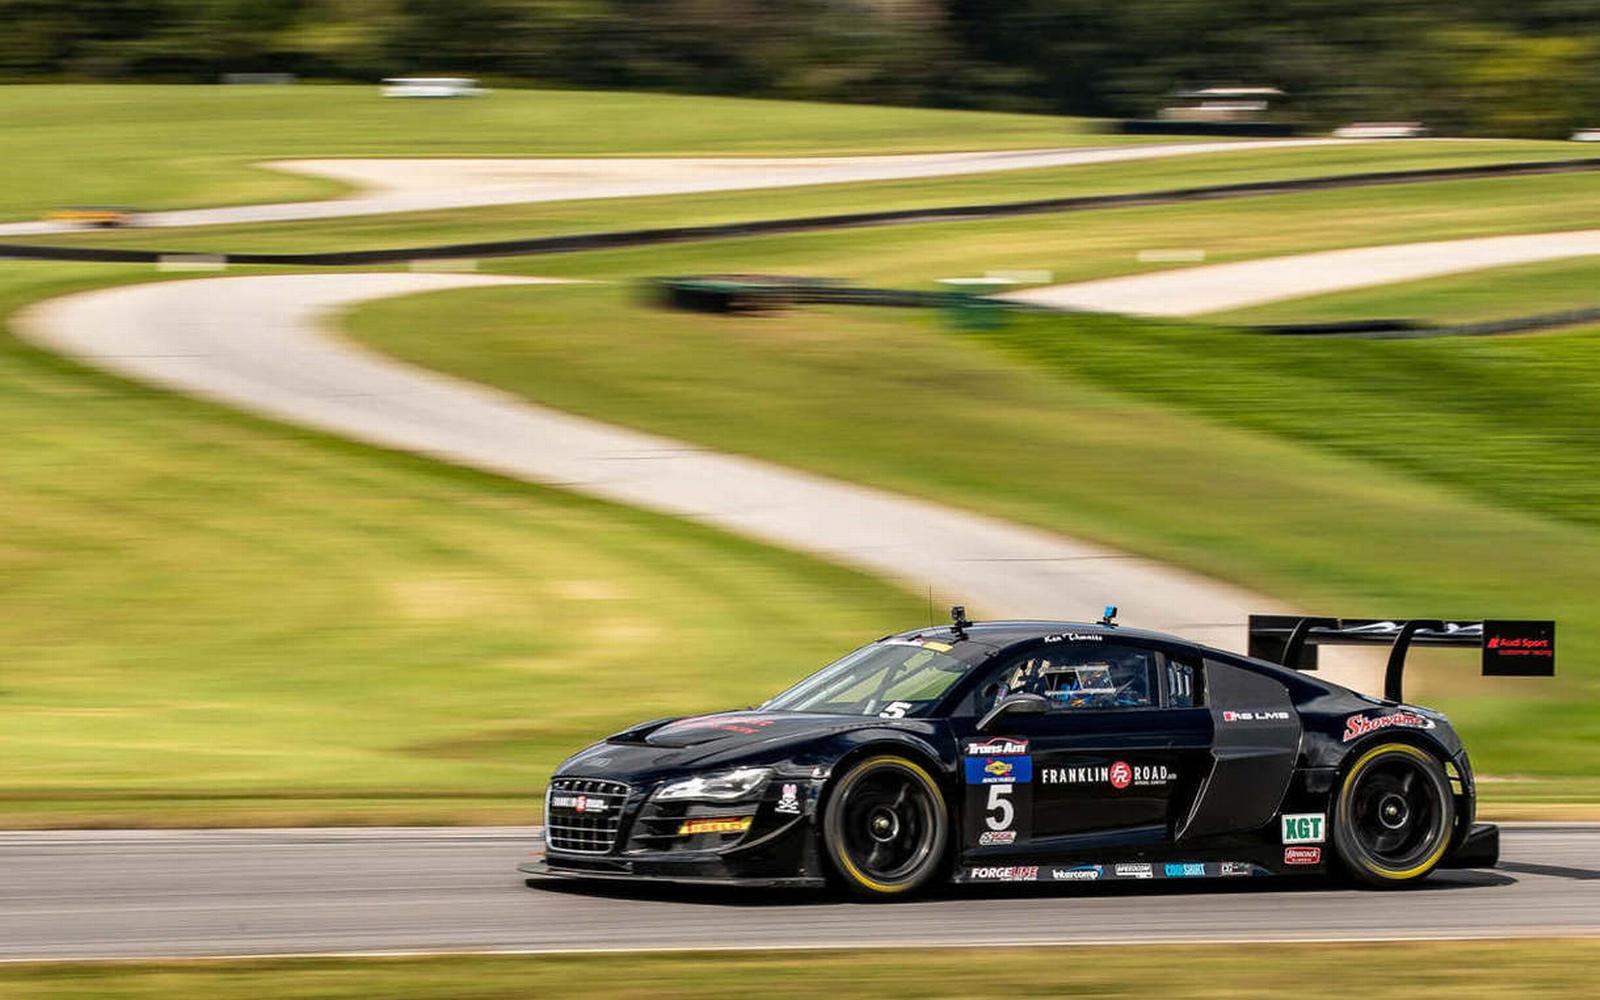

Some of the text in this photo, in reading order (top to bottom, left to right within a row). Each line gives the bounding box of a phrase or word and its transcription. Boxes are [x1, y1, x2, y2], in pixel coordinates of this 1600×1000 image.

[1500, 638, 1549, 648] Audi Sport
[879, 701, 912, 718] 5
[968, 742, 1026, 754] Trans Am
[1041, 767, 1109, 784] FRANKLIN
[1134, 766, 1168, 780] ROAD
[985, 784, 1014, 831] 5
[1285, 817, 1322, 839] XGT
[970, 866, 1039, 879] FORGELINE
[1052, 868, 1099, 881] Intercomp
